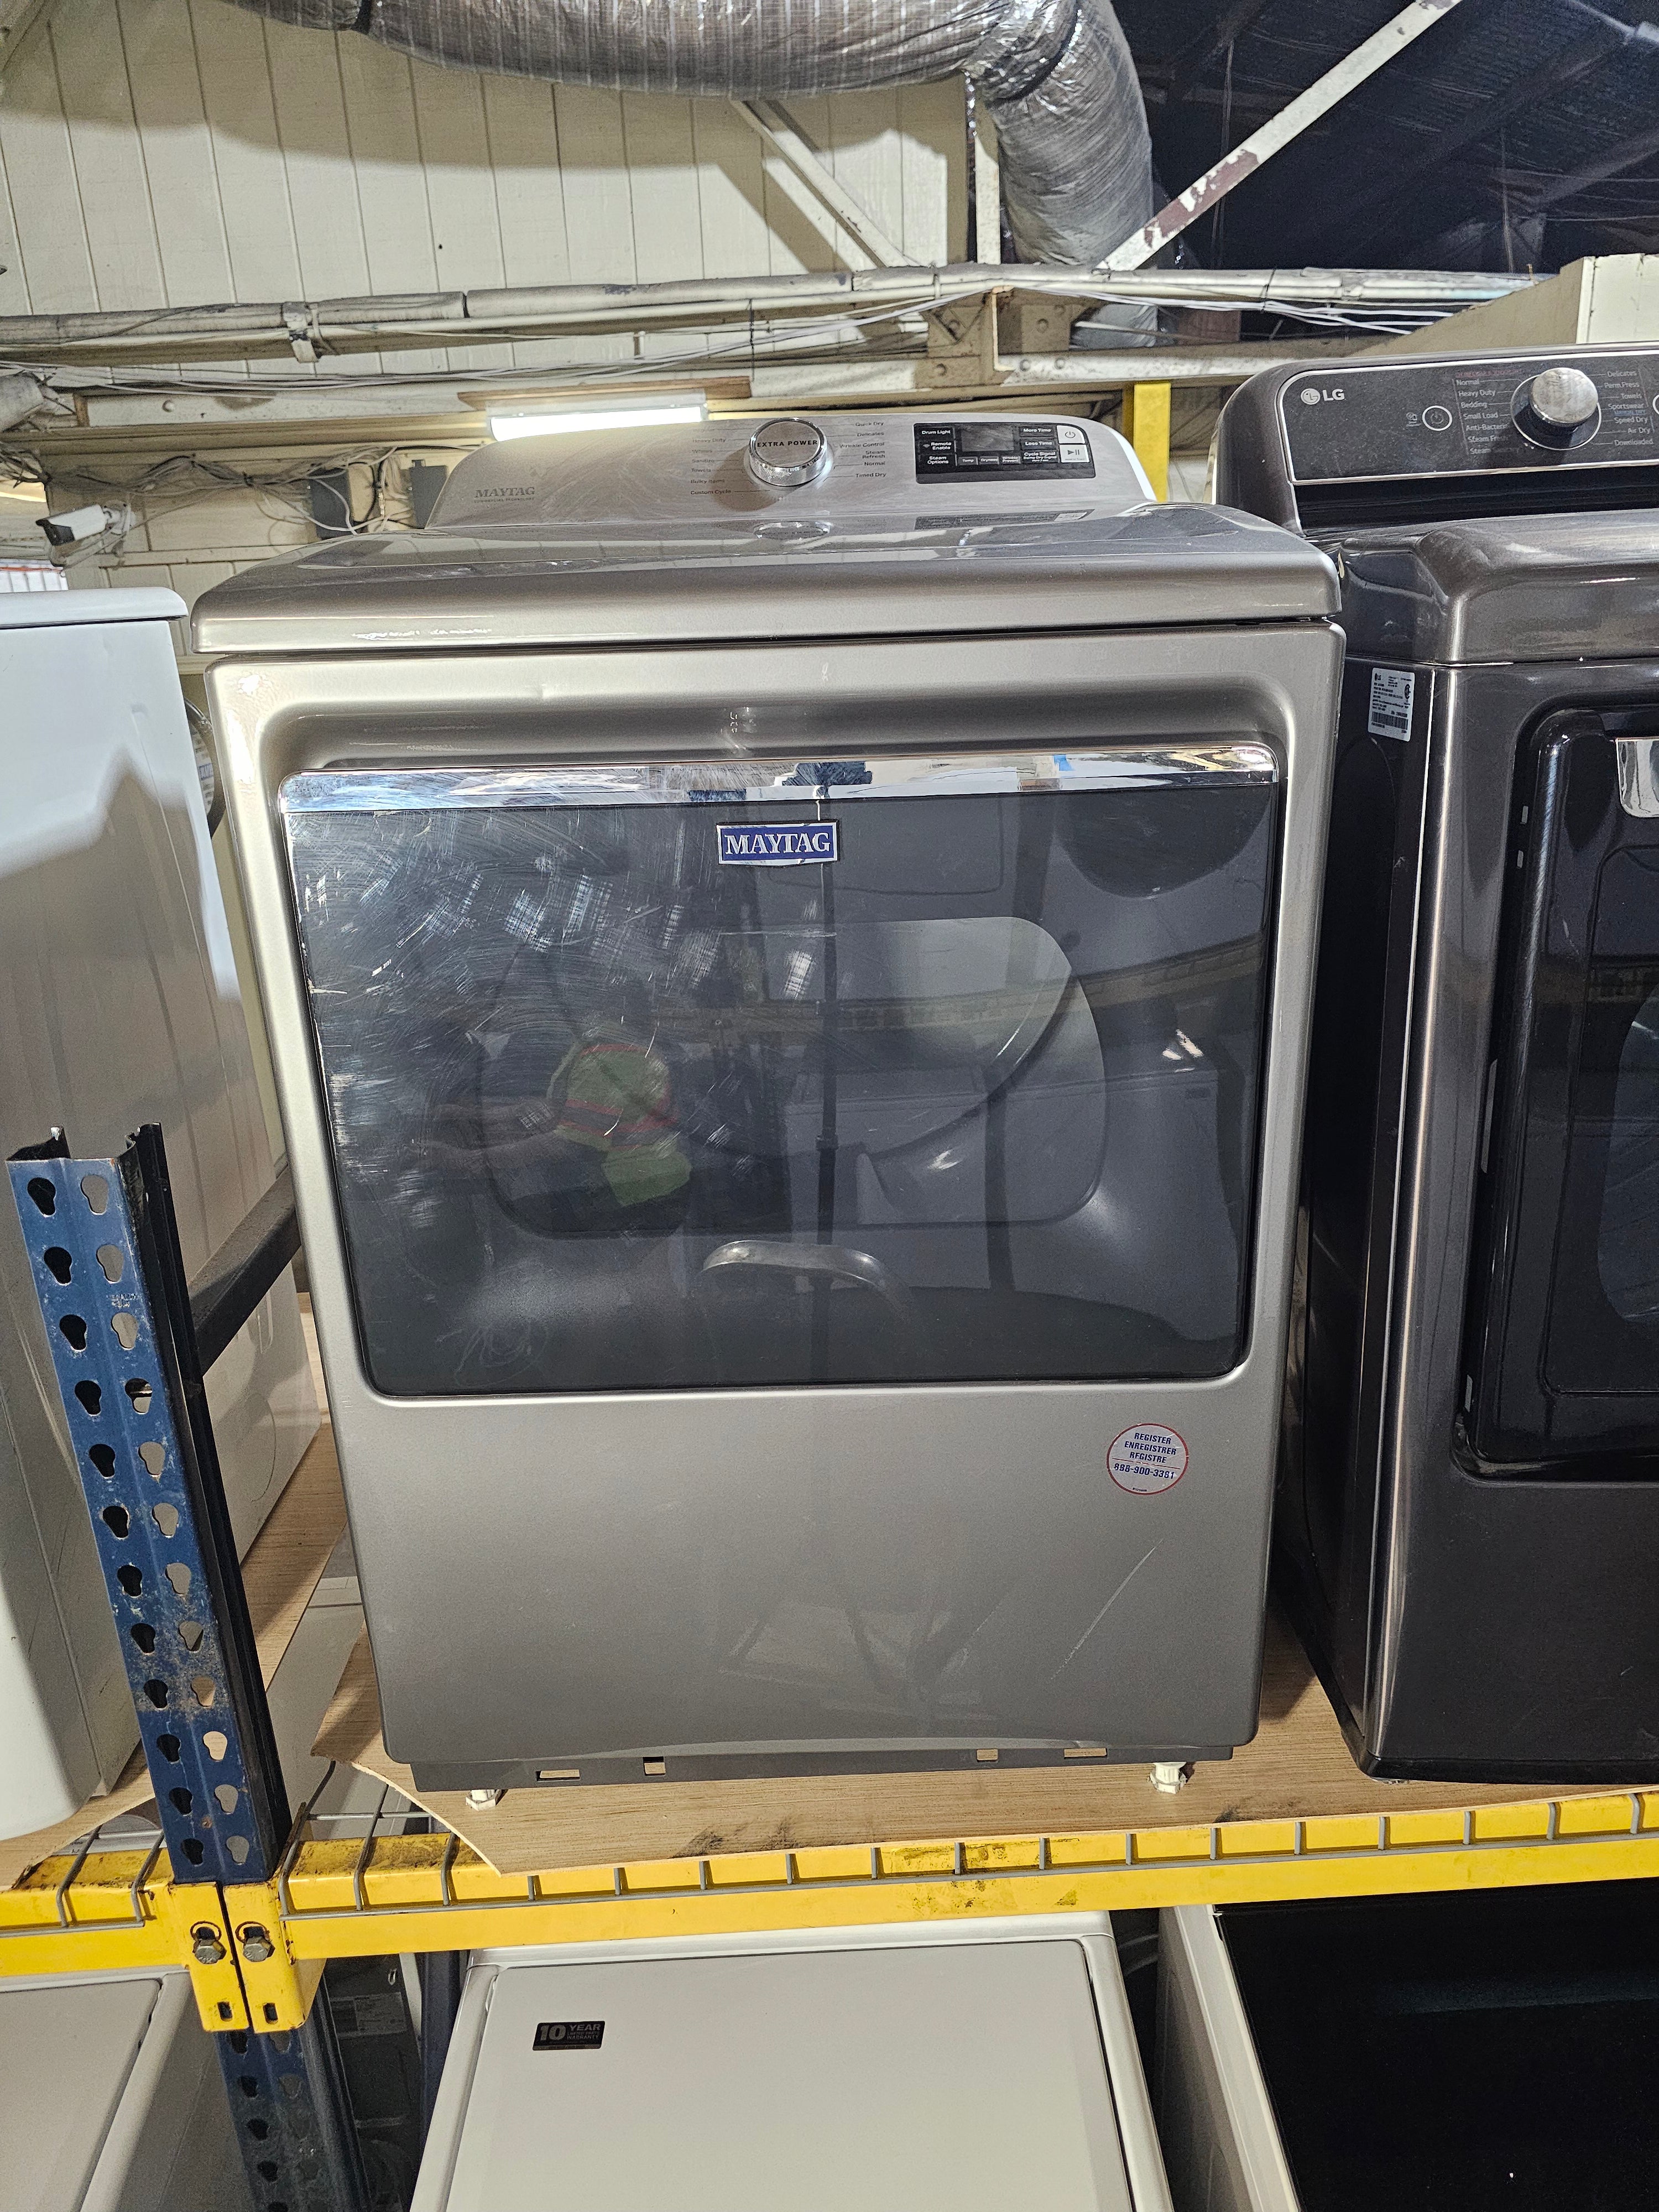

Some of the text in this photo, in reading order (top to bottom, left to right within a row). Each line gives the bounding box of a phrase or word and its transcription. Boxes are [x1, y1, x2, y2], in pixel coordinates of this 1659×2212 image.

[1322, 389, 1345, 401] LG
[474, 487, 535, 498] MAYTAG
[724, 832, 830, 854] MAYTAG
[1134, 1432, 1171, 1444] REGISTER
[1124, 1441, 1177, 1455] ENREGISTRER
[1129, 1452, 1167, 1463] REGISTRE
[1114, 1463, 1175, 1479] 888-900-3381
[540, 2025, 566, 2041] 10
